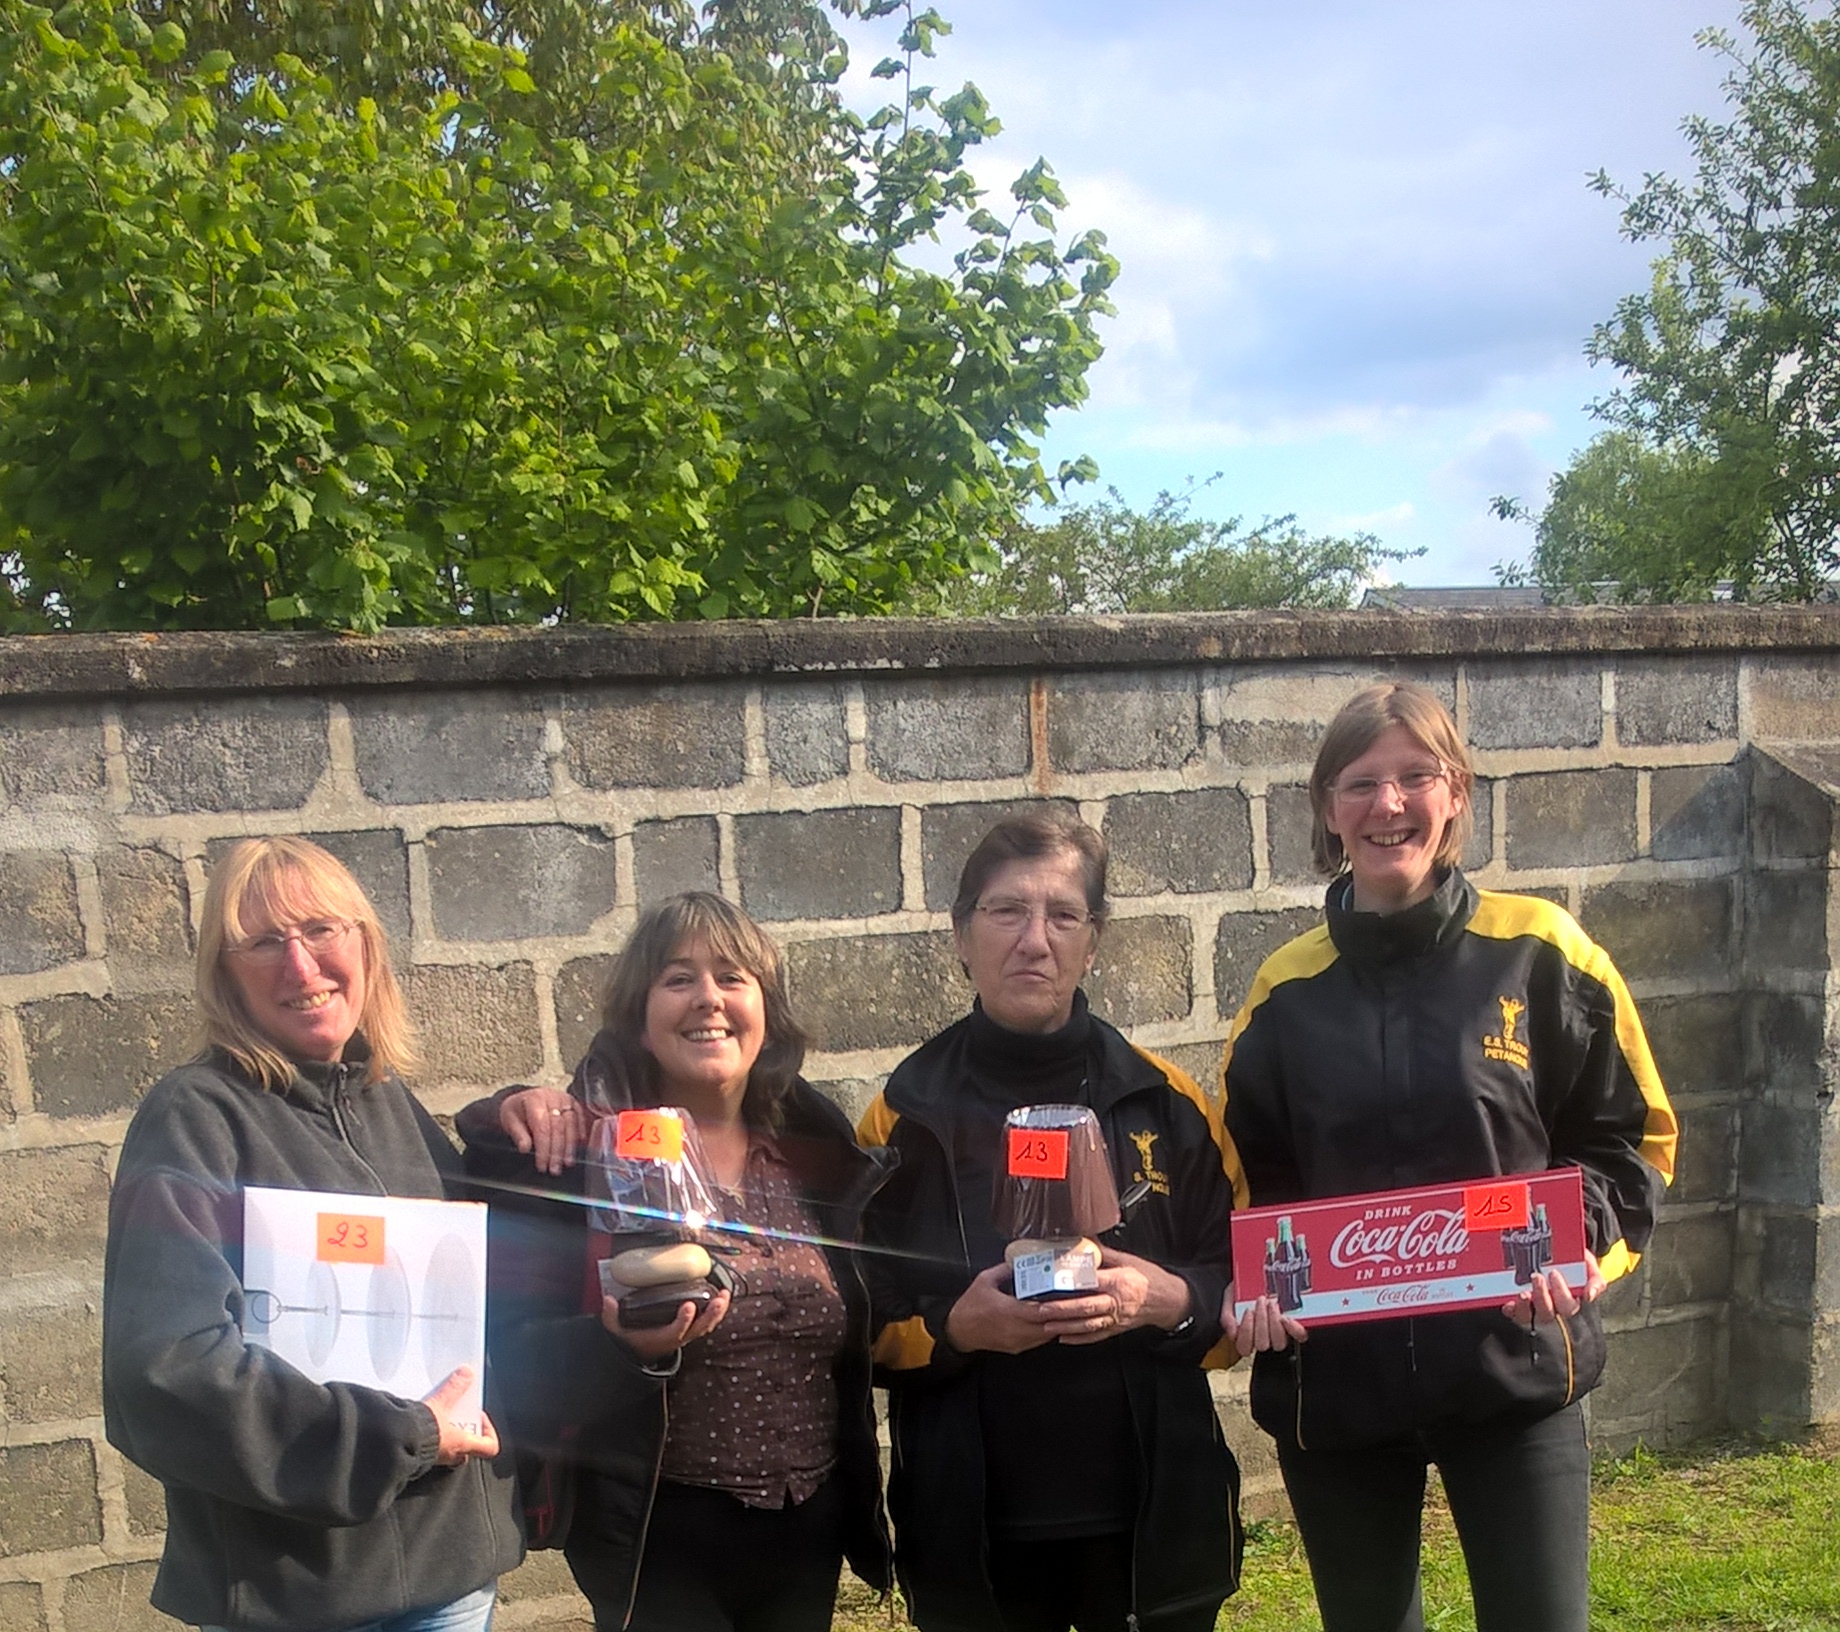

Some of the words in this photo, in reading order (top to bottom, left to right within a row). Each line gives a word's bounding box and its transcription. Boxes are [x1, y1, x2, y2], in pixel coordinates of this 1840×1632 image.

[625, 1123, 662, 1144] 13
[1015, 1141, 1048, 1162] 13
[1364, 1205, 1412, 1221] DRINK
[1473, 1195, 1513, 1217] 15
[327, 1221, 369, 1248] 23
[1329, 1209, 1470, 1269] Coca-Cola
[1355, 1269, 1374, 1281] IN
[1380, 1259, 1457, 1278] BOTTLES
